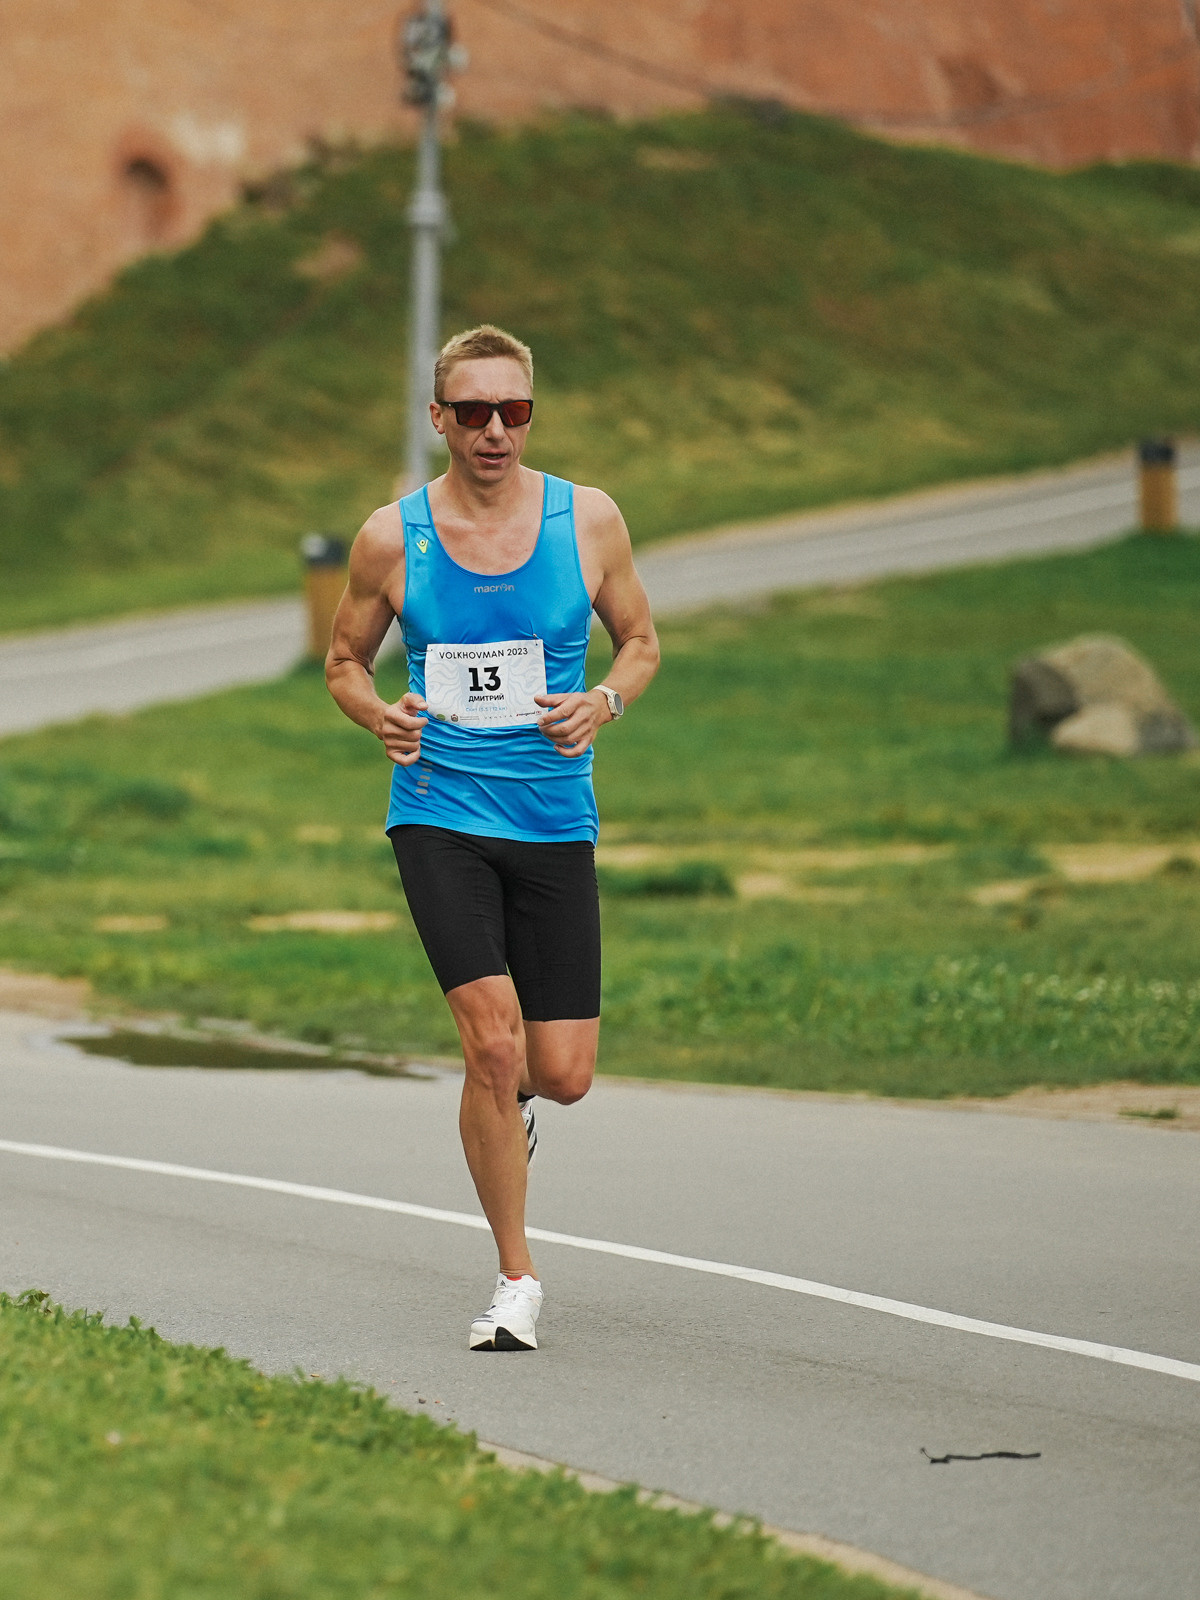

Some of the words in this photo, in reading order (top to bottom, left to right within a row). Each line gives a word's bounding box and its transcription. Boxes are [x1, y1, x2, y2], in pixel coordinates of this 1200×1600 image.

[473, 583, 516, 593] macron
[439, 649, 504, 660] VOLKHOVMAN
[507, 647, 528, 656] 2023
[468, 666, 501, 691] 13
[468, 693, 504, 702] ДМИТРИЙ
